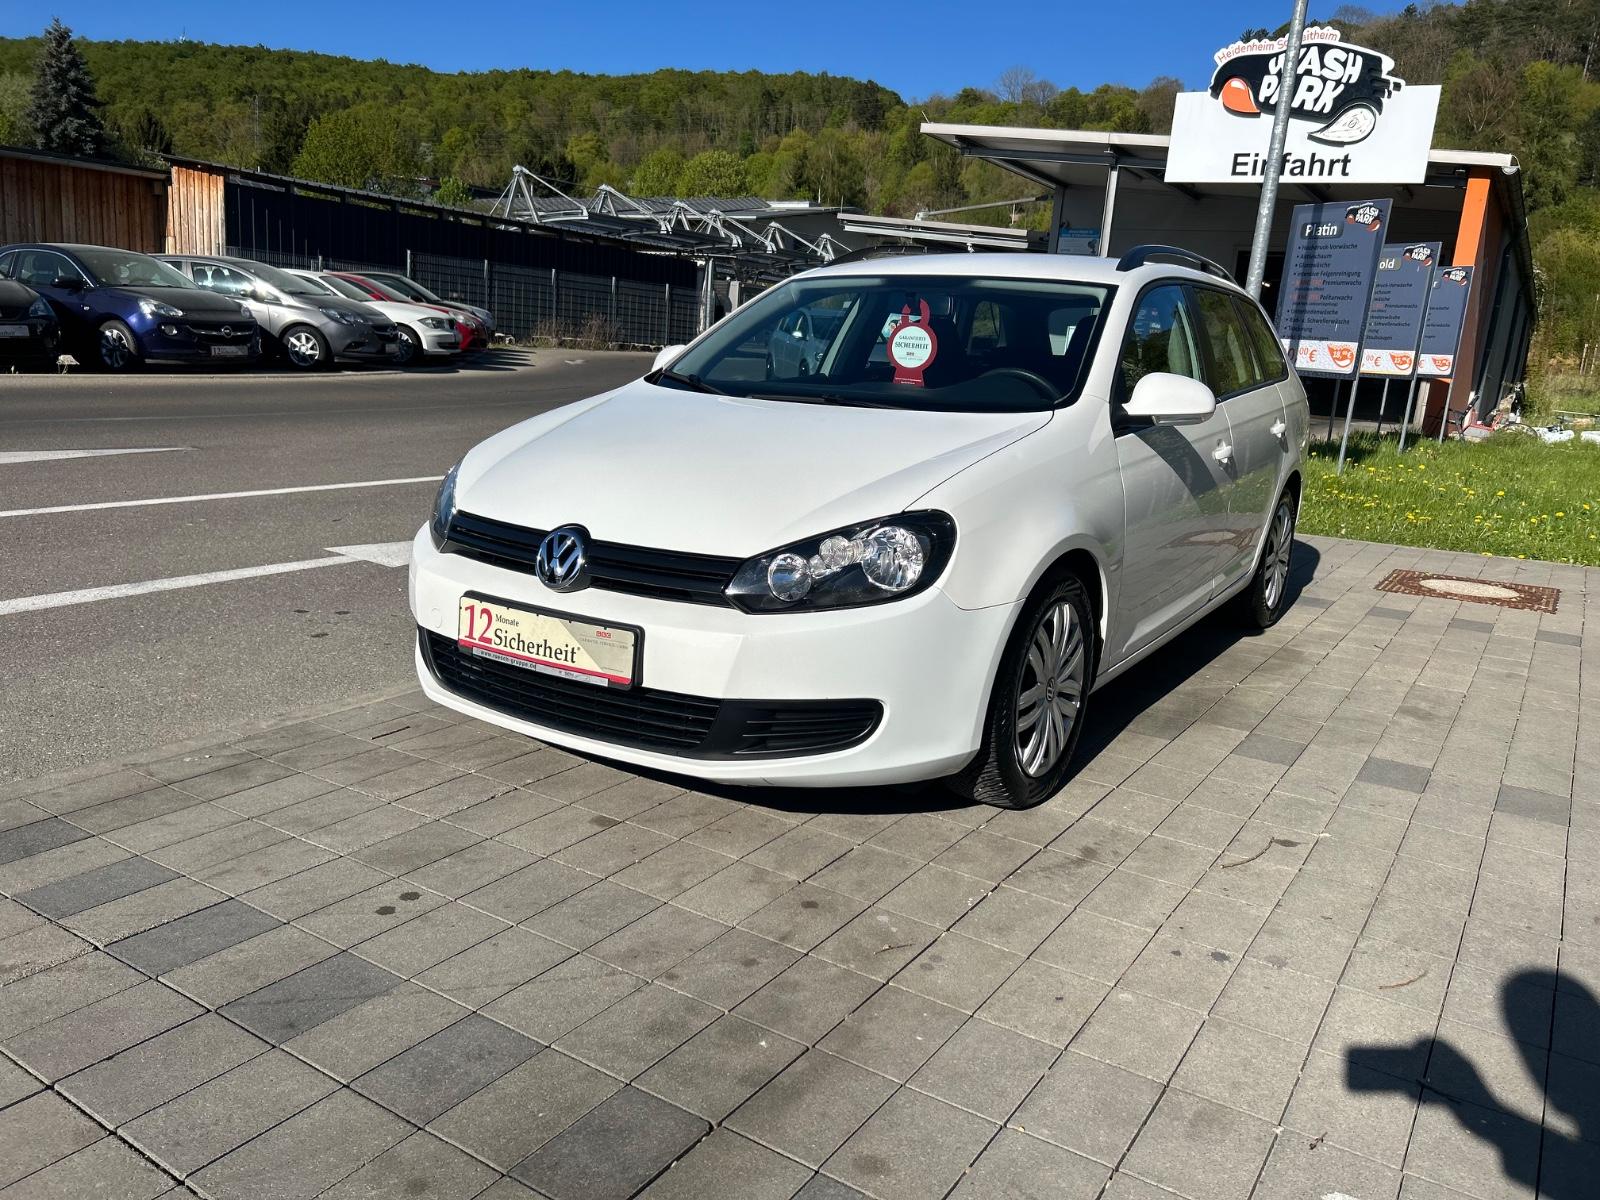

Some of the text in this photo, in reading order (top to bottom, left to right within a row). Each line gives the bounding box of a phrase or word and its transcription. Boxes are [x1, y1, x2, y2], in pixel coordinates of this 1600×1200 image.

[1217, 41, 1275, 63] Heidenheim
[1355, 213, 1375, 225] PARK
[1358, 206, 1379, 218] WASH
[1305, 223, 1338, 237] Platin
[1379, 259, 1395, 269] old
[464, 604, 493, 646] 12
[495, 613, 520, 628] Monate
